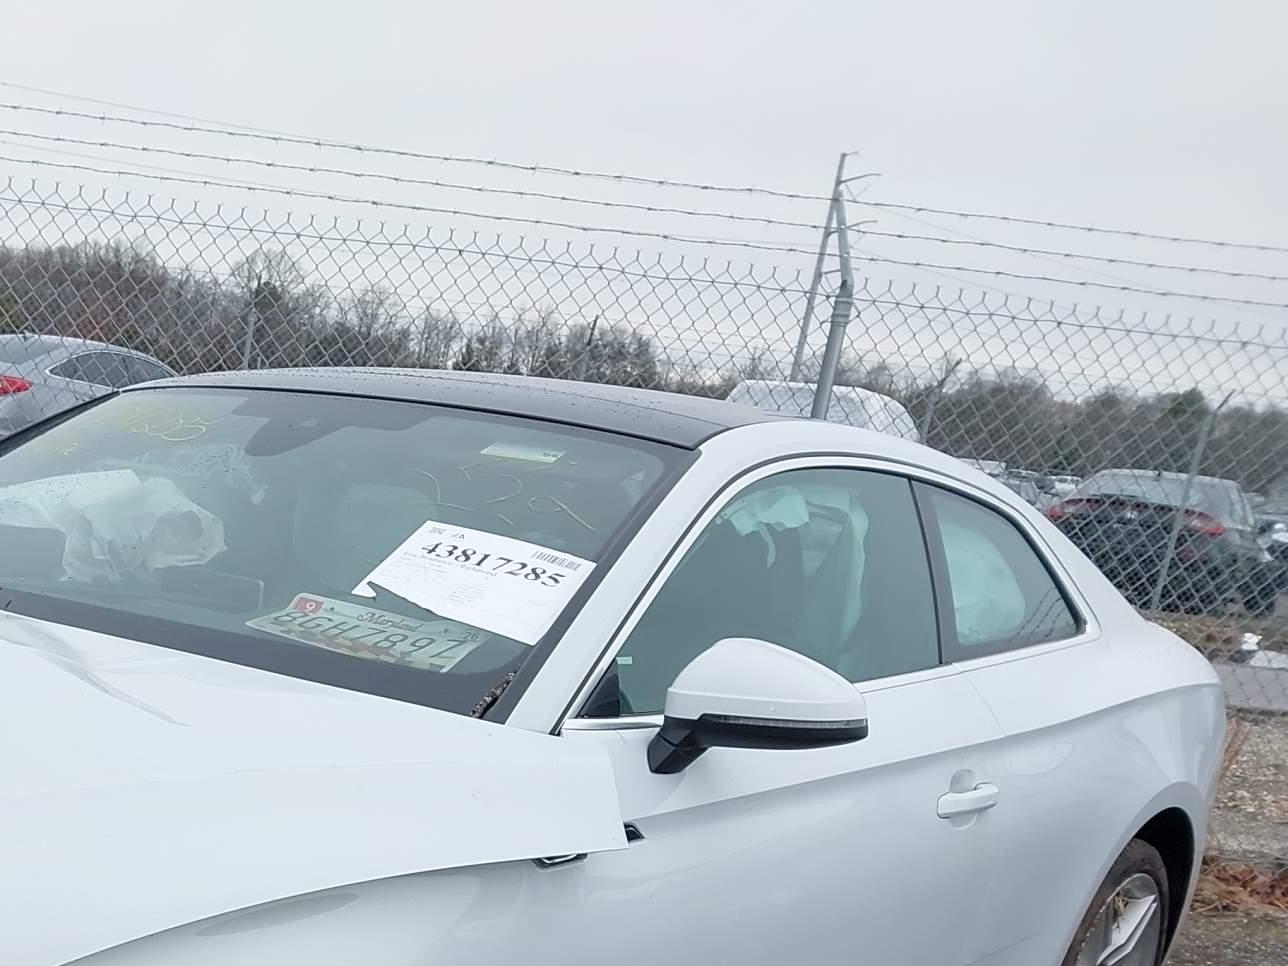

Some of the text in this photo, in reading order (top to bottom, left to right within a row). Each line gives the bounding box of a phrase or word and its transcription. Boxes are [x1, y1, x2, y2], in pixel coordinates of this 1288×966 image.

[420, 541, 567, 587] 43817285
[305, 601, 317, 611] 9
[357, 611, 425, 633] Maryland
